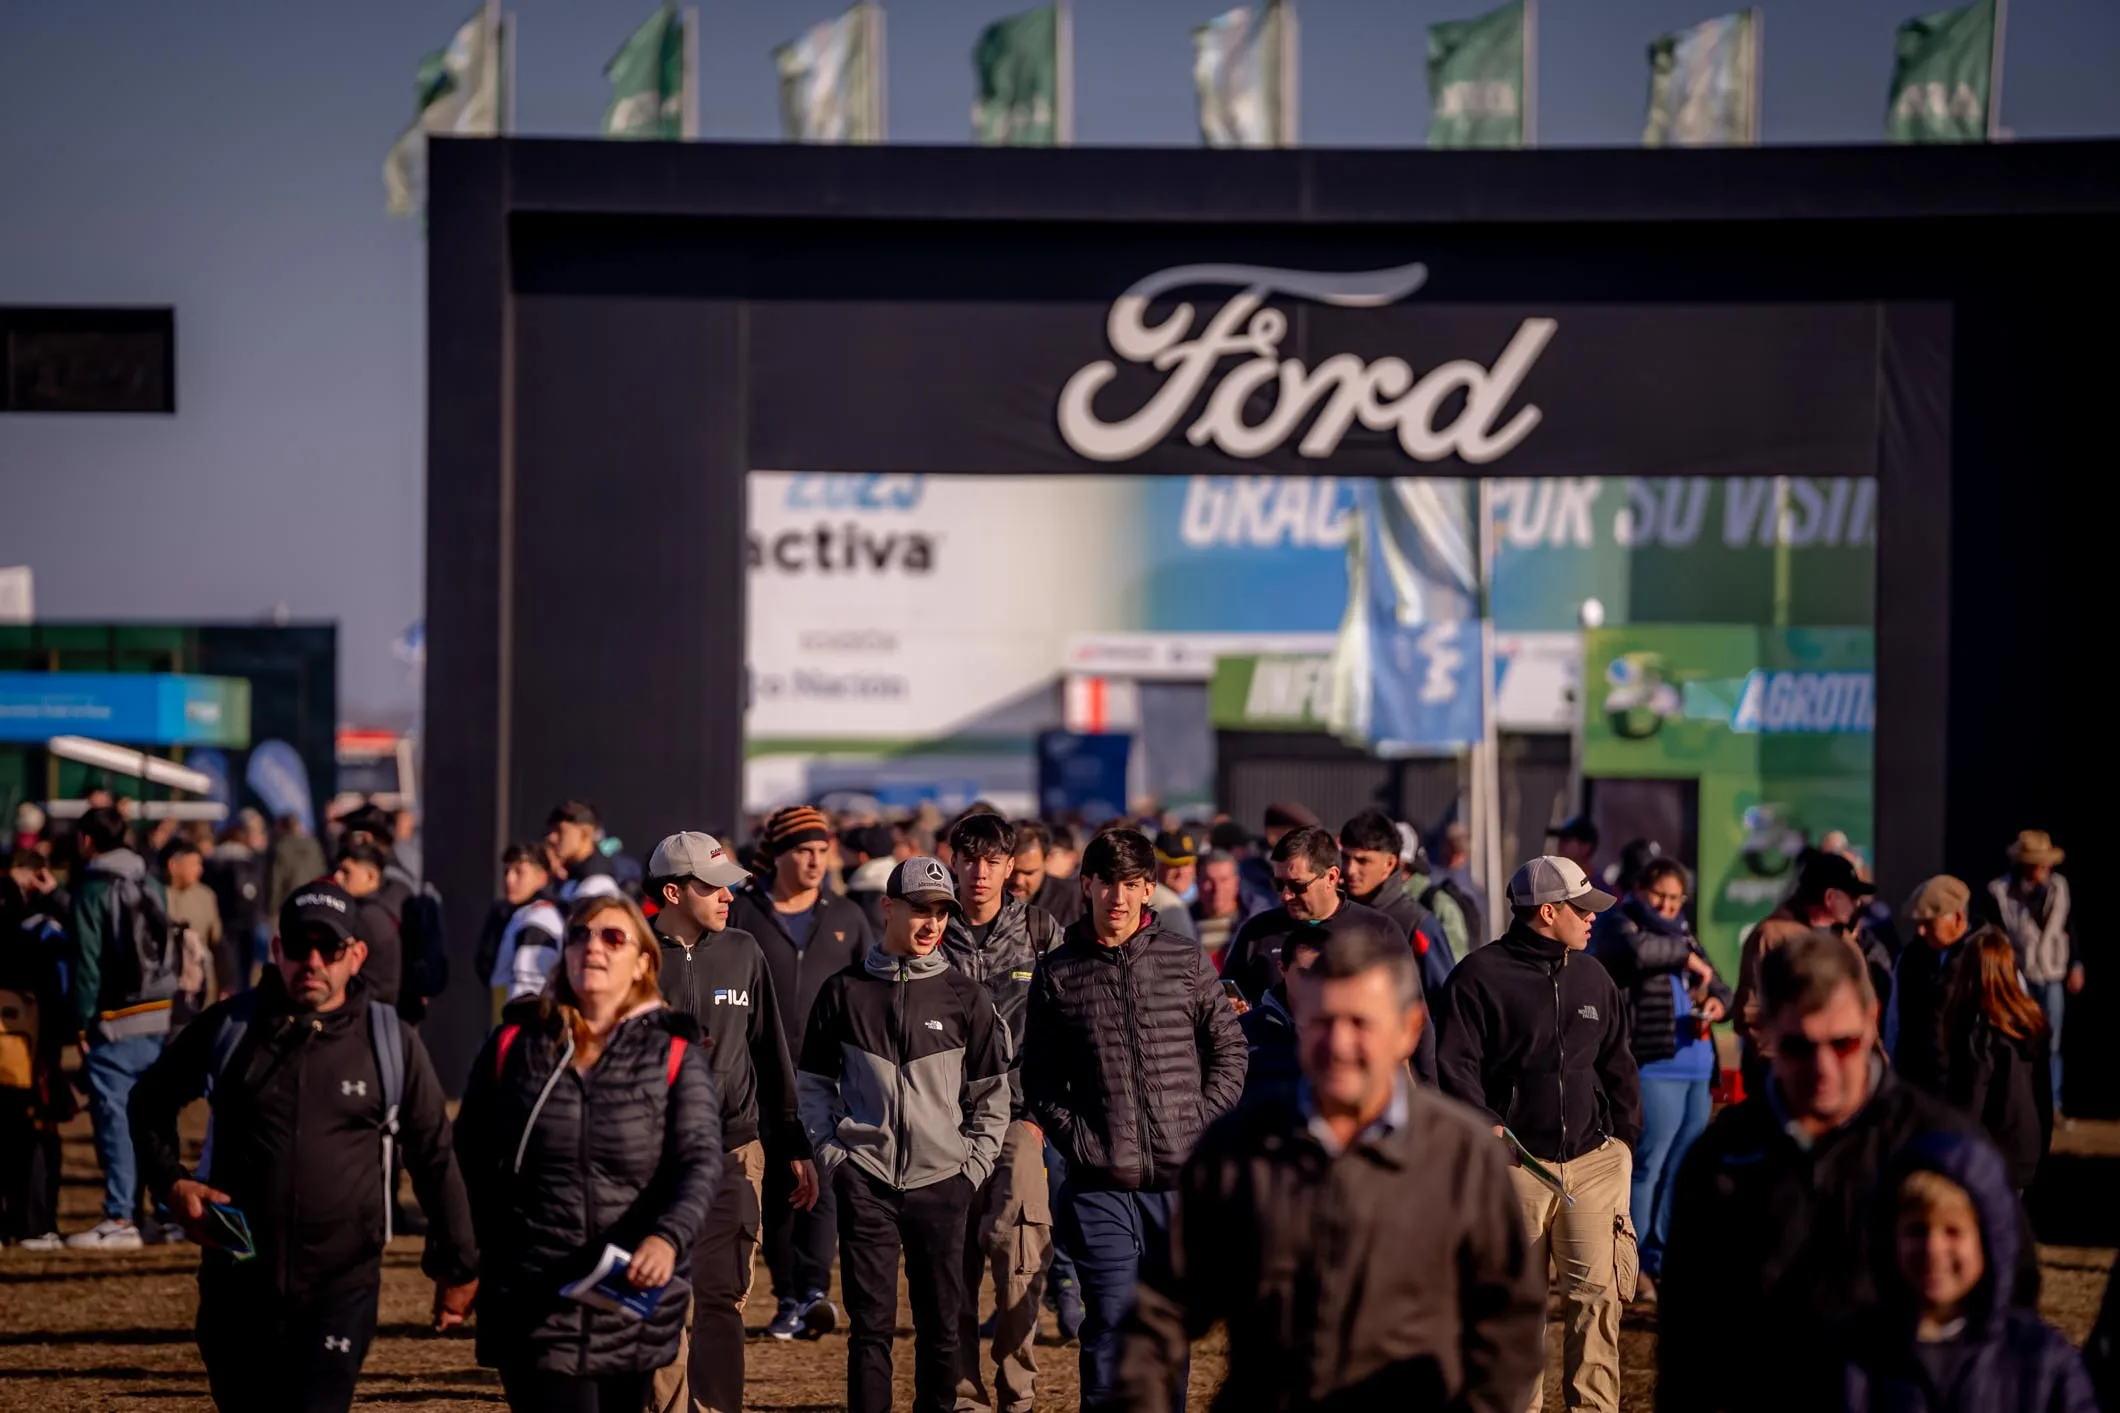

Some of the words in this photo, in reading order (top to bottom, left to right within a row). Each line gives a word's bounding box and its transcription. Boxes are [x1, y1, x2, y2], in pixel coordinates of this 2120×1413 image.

[1057, 262, 1559, 463] Ford
[1181, 474, 1352, 546] GRAC
[714, 989, 749, 1006] FILA
